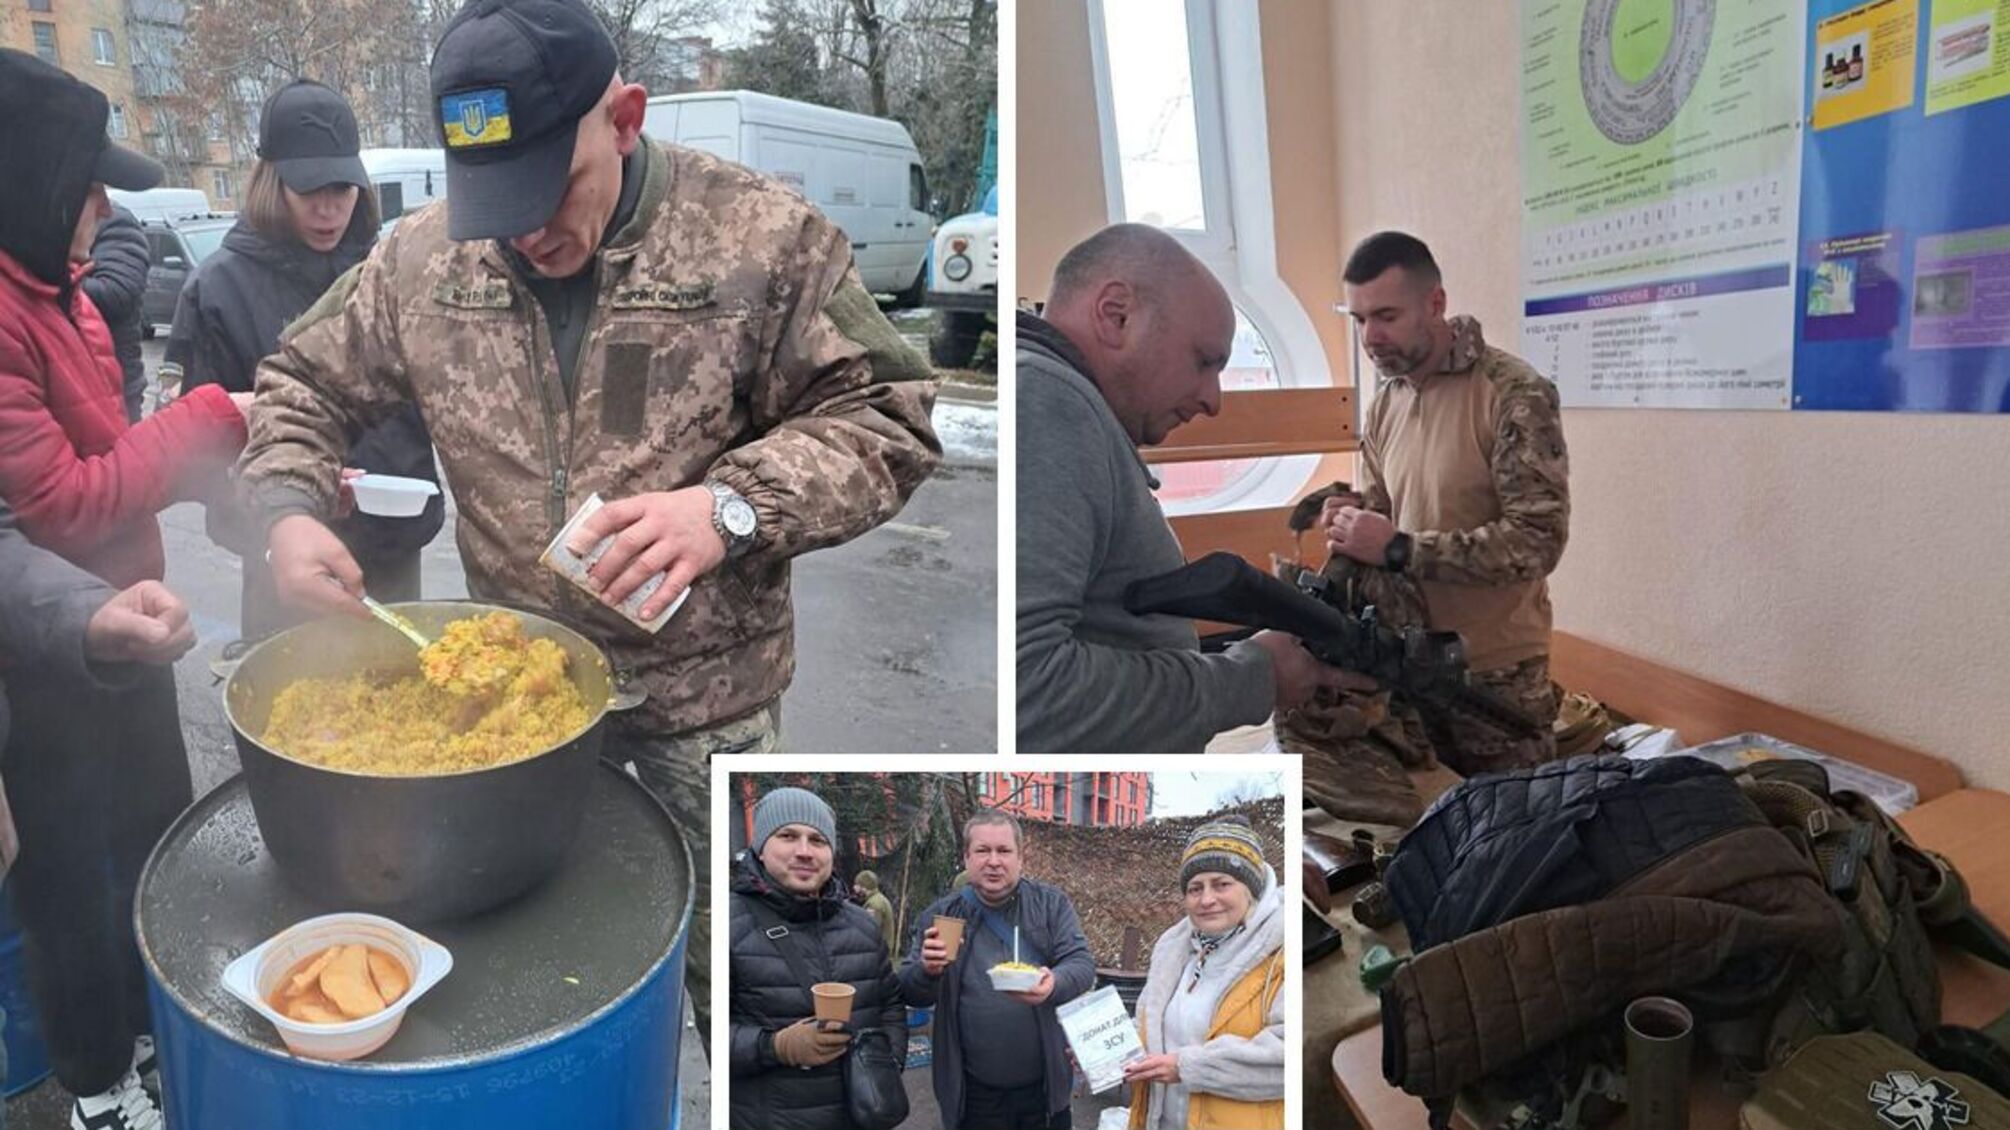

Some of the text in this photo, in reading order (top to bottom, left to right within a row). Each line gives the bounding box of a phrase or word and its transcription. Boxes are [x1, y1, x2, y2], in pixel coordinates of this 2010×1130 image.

[1656, 281, 1698, 300] ДИСКІВ
[1082, 1020, 1112, 1042] ДОНАТ
[1103, 1032, 1125, 1050] ЗСУ
